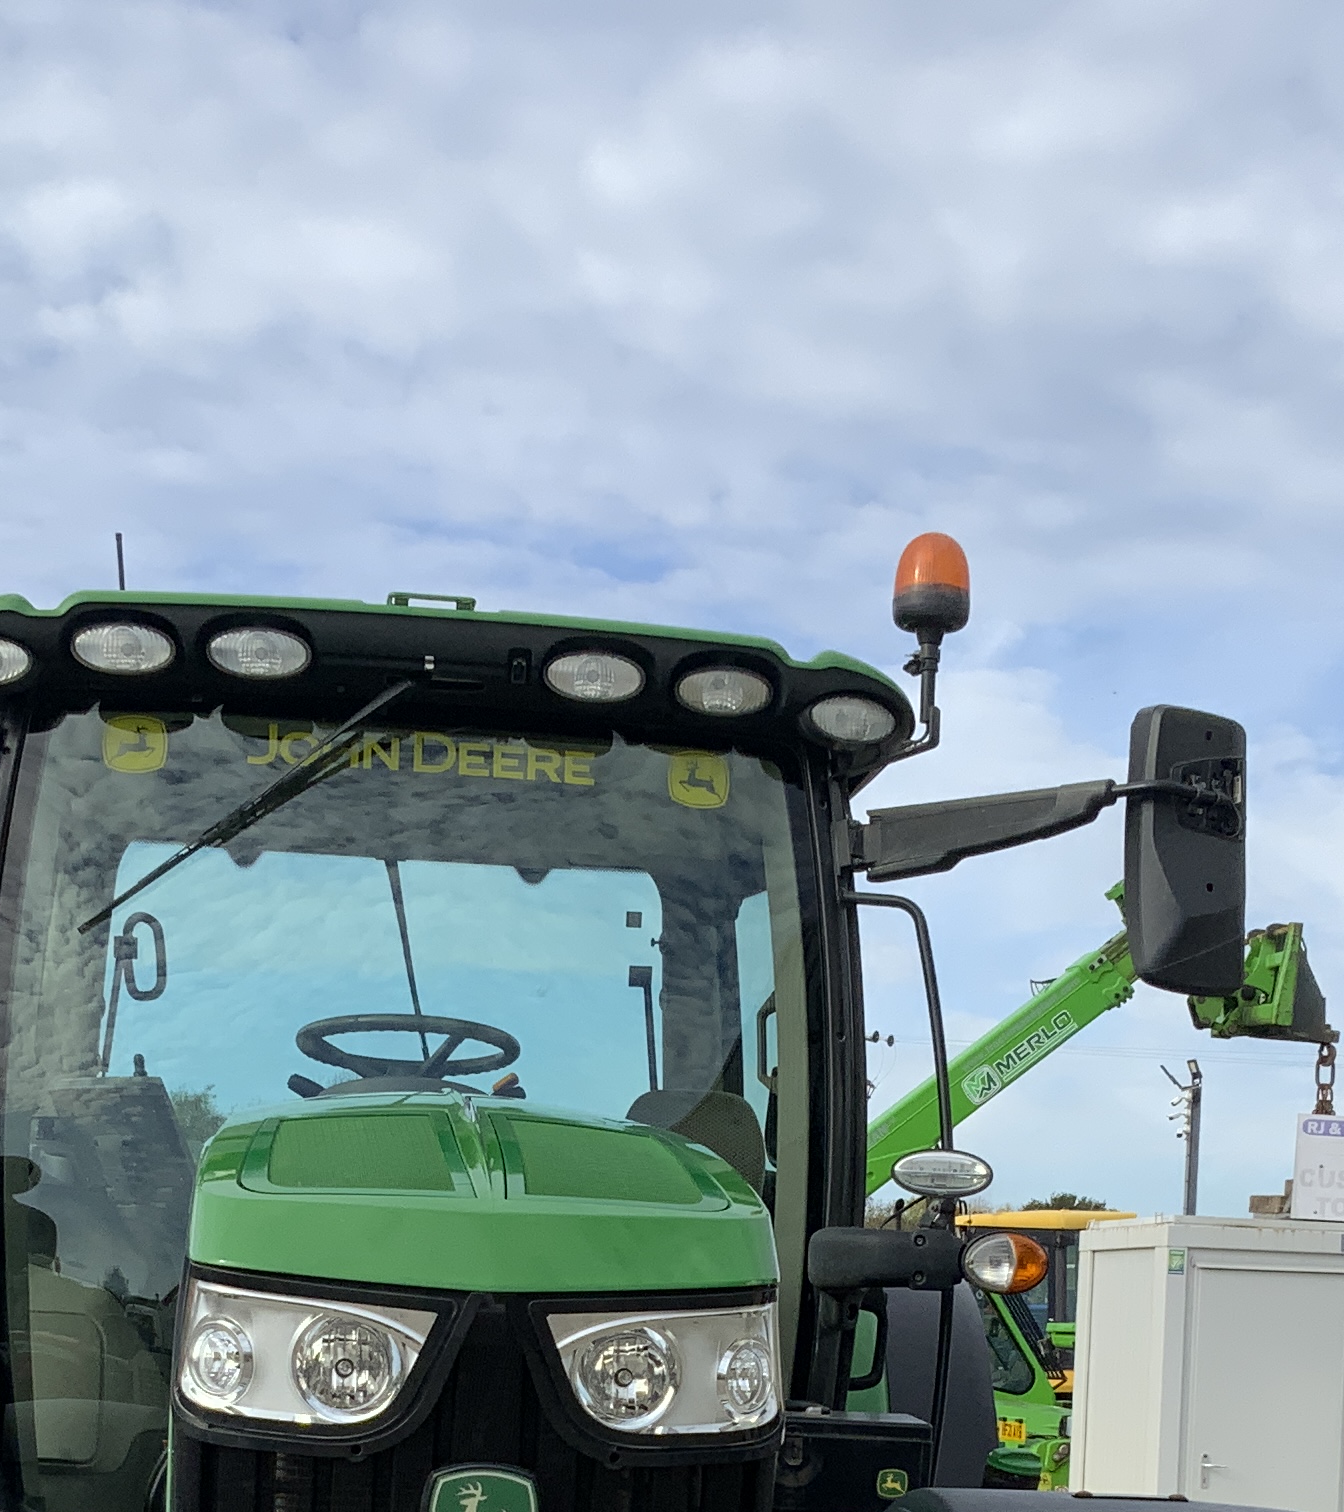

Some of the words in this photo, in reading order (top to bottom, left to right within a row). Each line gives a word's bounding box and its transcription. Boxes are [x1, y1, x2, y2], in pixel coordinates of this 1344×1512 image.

[246, 722, 400, 771] JON
[412, 731, 595, 786] DEERE
[993, 1010, 1073, 1077] MERLO
[1307, 1121, 1325, 1134] RJ
[1328, 1123, 1342, 1136] &
